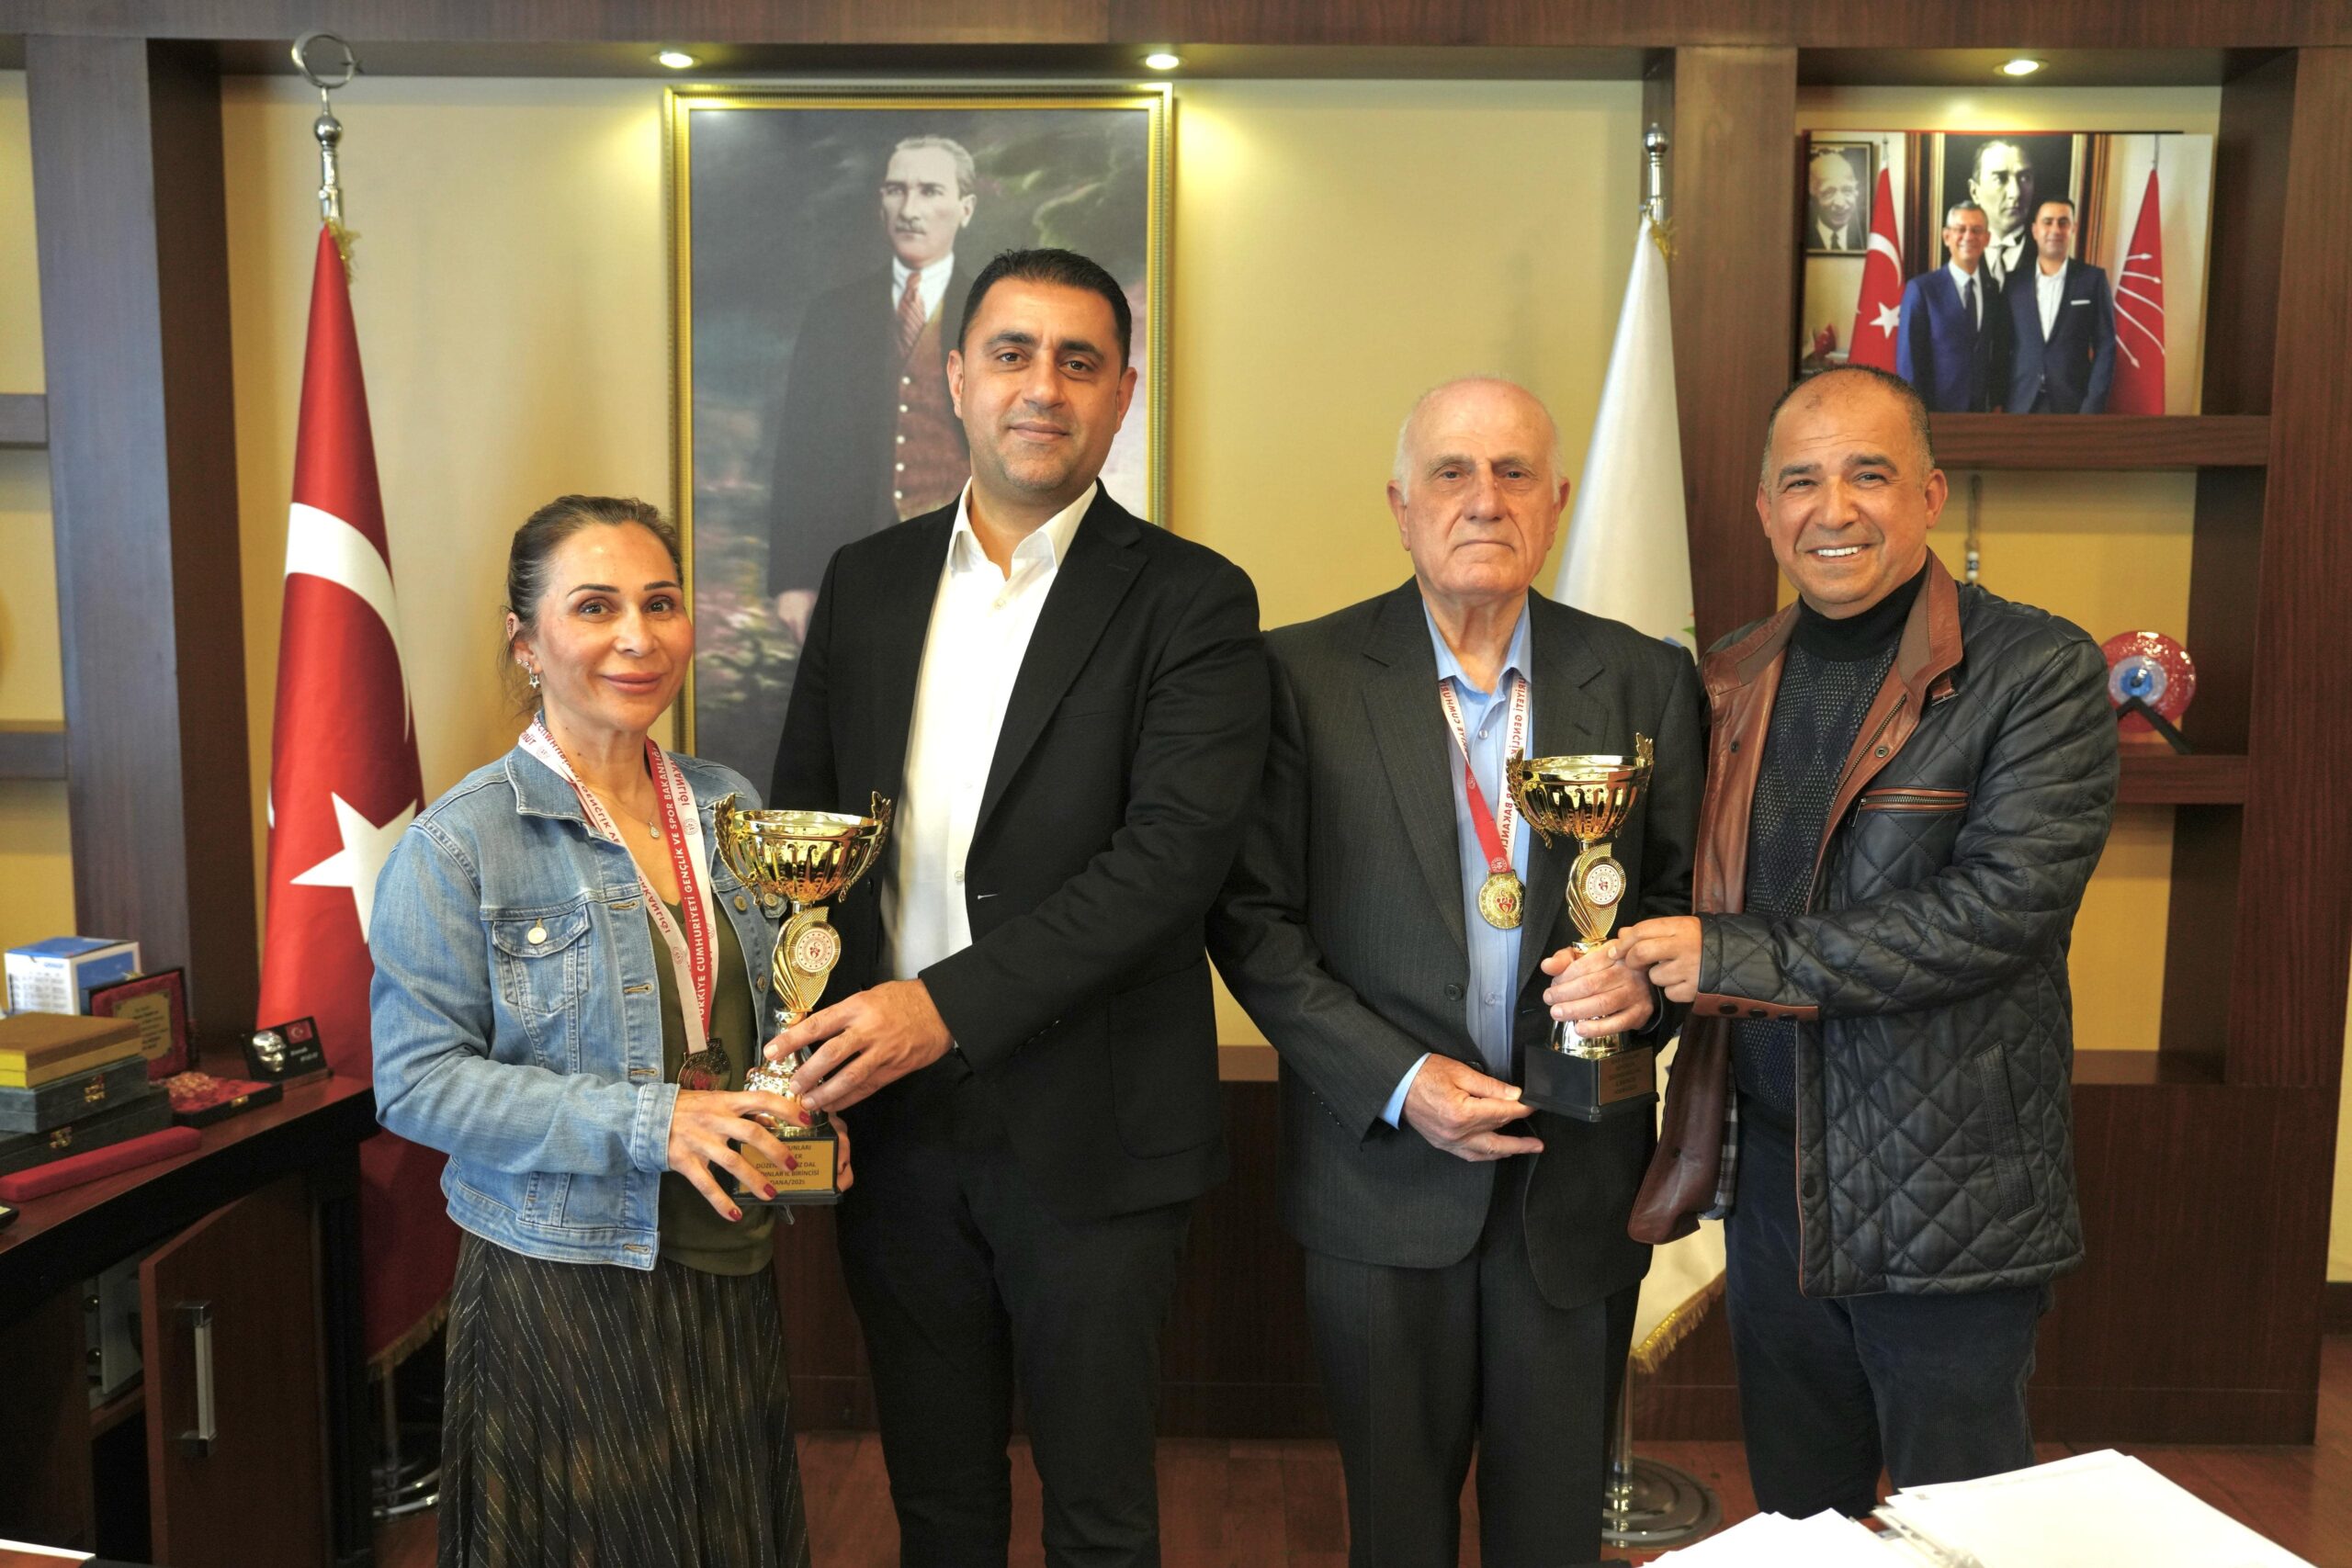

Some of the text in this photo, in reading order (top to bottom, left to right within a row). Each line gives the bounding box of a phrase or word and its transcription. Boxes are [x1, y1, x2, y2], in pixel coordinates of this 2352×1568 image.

[666, 803, 678, 829] SPOR
[671, 832, 681, 845] VE
[674, 848, 693, 893] GENÇLİK
[684, 896, 706, 972] CUMHURİYETİ
